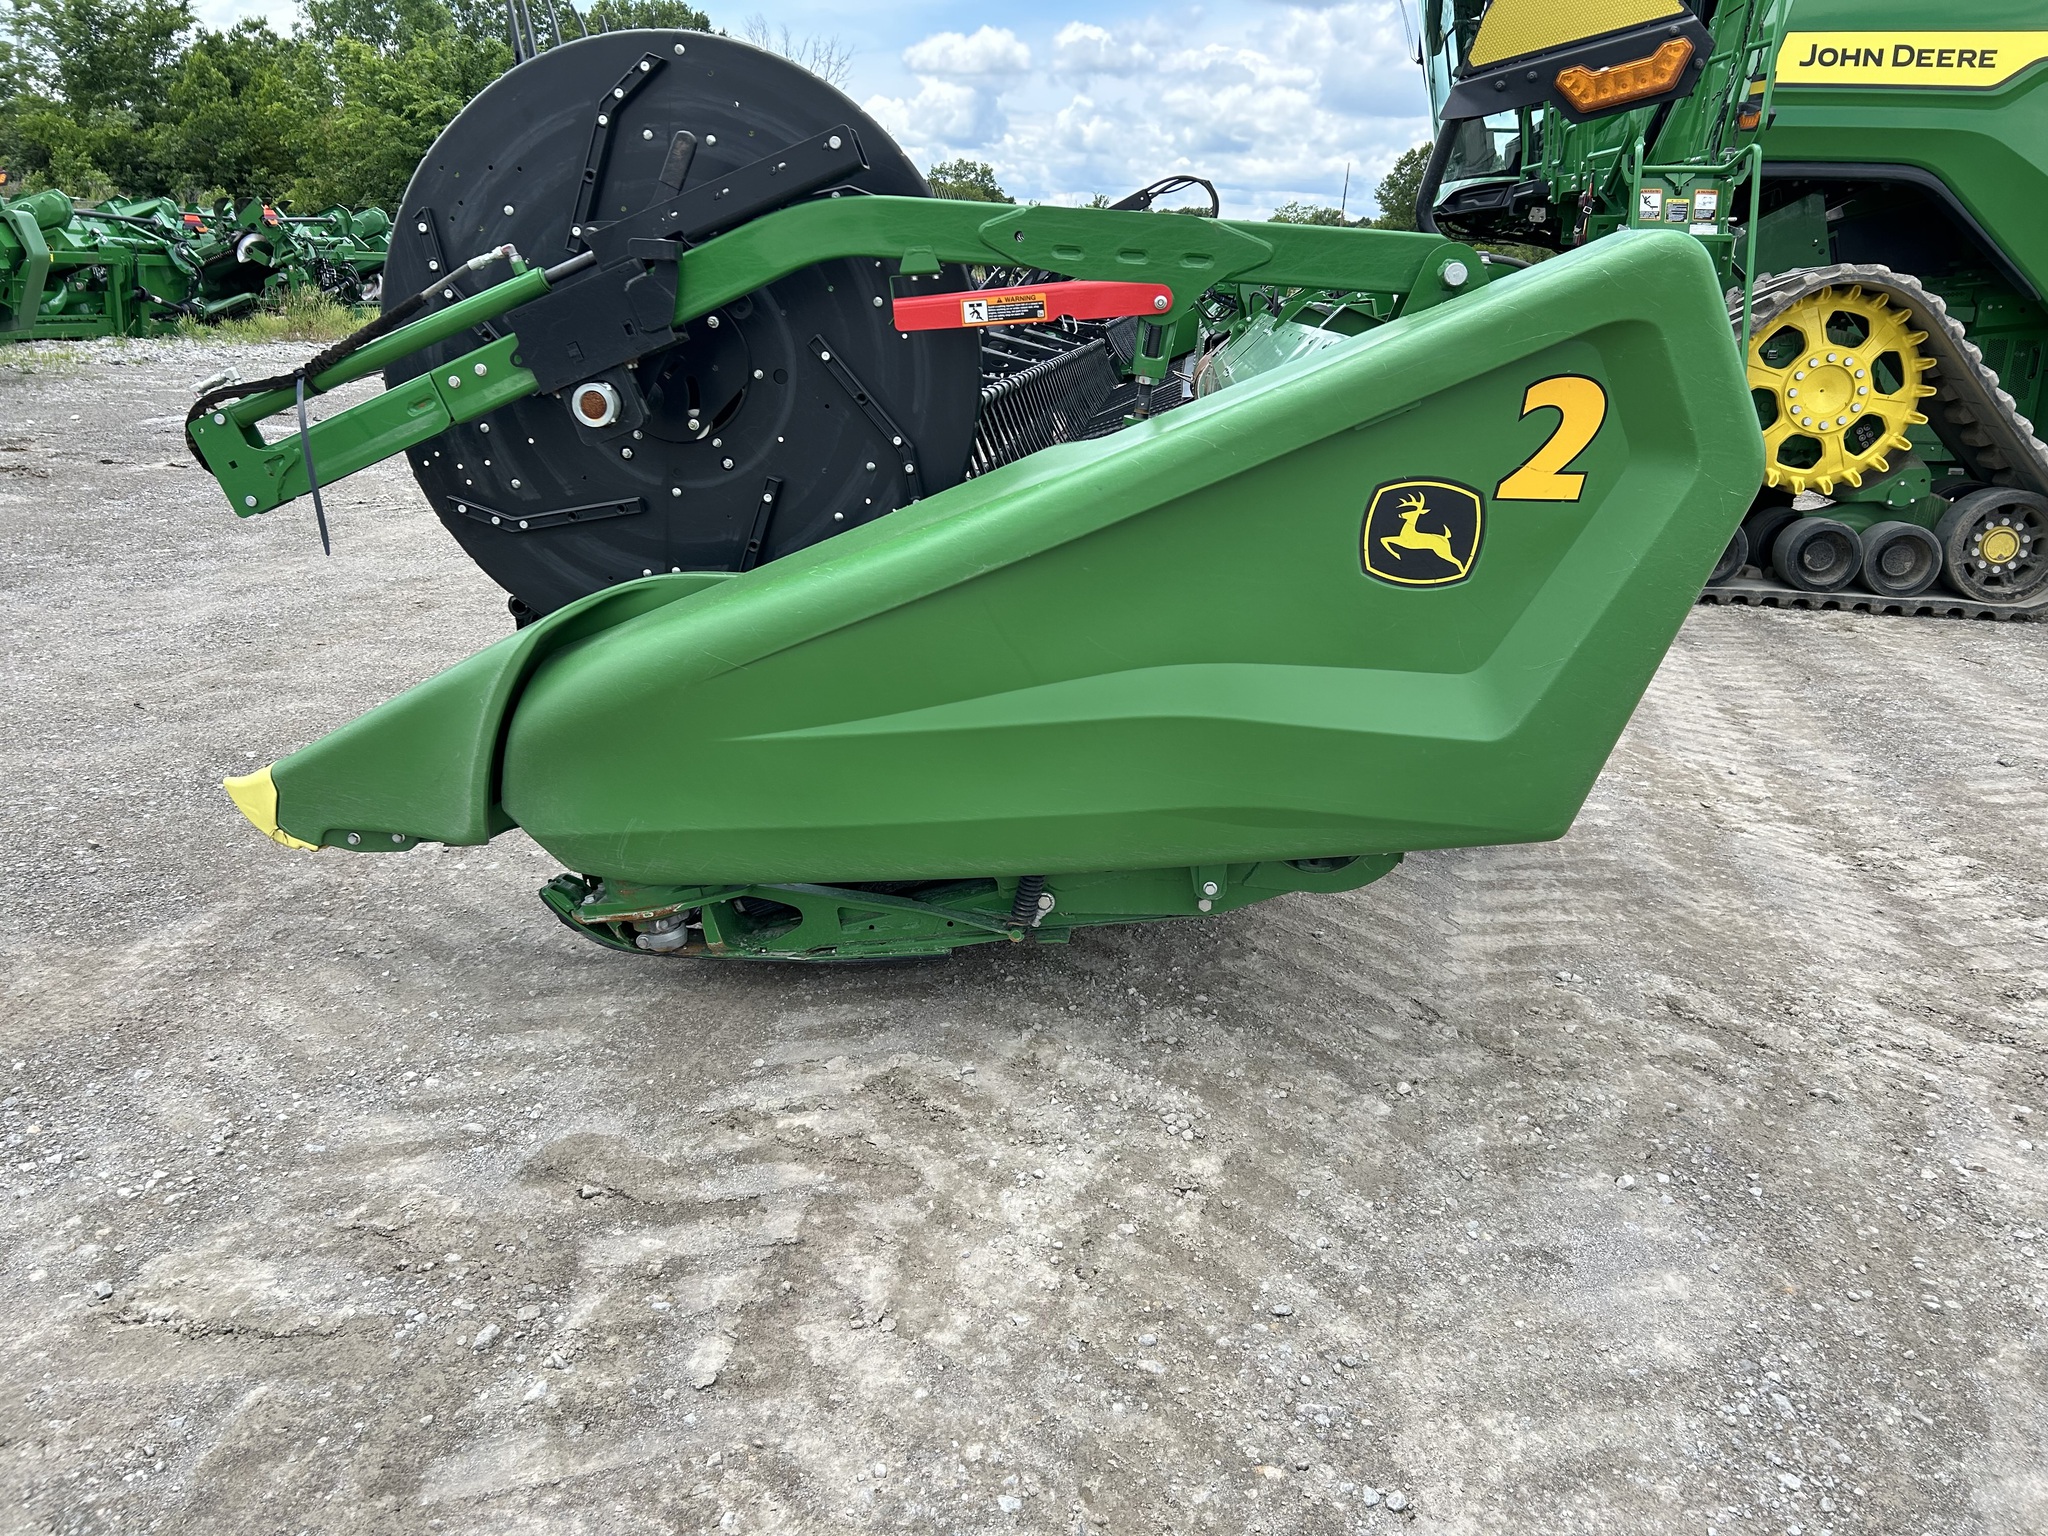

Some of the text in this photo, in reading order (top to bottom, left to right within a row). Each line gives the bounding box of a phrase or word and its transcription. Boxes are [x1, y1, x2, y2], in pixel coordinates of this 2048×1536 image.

[1799, 44, 1998, 68] JOHN DEERE
[1004, 294, 1036, 302] WARNING
[1492, 373, 1608, 503] 2
